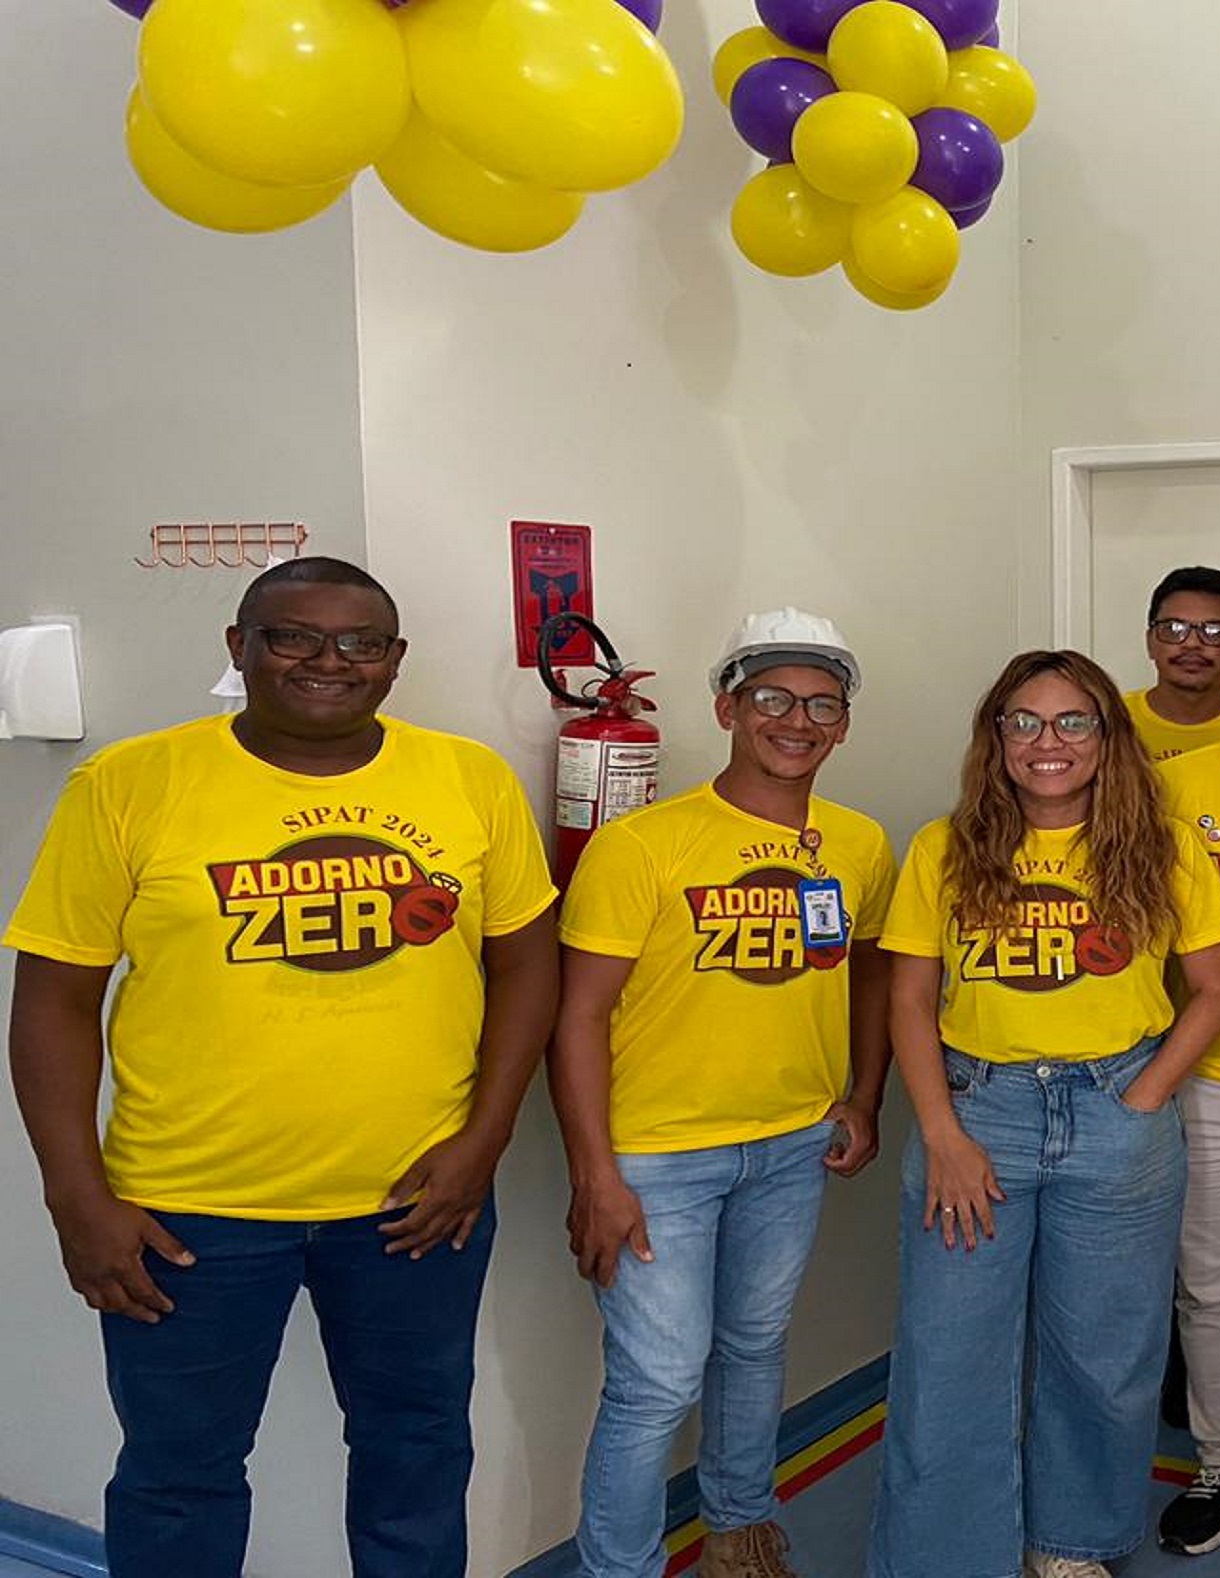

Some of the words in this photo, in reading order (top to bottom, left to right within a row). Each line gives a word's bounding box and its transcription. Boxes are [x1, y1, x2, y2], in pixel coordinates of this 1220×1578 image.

[282, 805, 373, 834] SIPAT
[381, 814, 445, 860] 2024
[738, 842, 805, 864] SIPAT
[228, 854, 413, 898] ADORNO
[701, 887, 802, 918] ADORN
